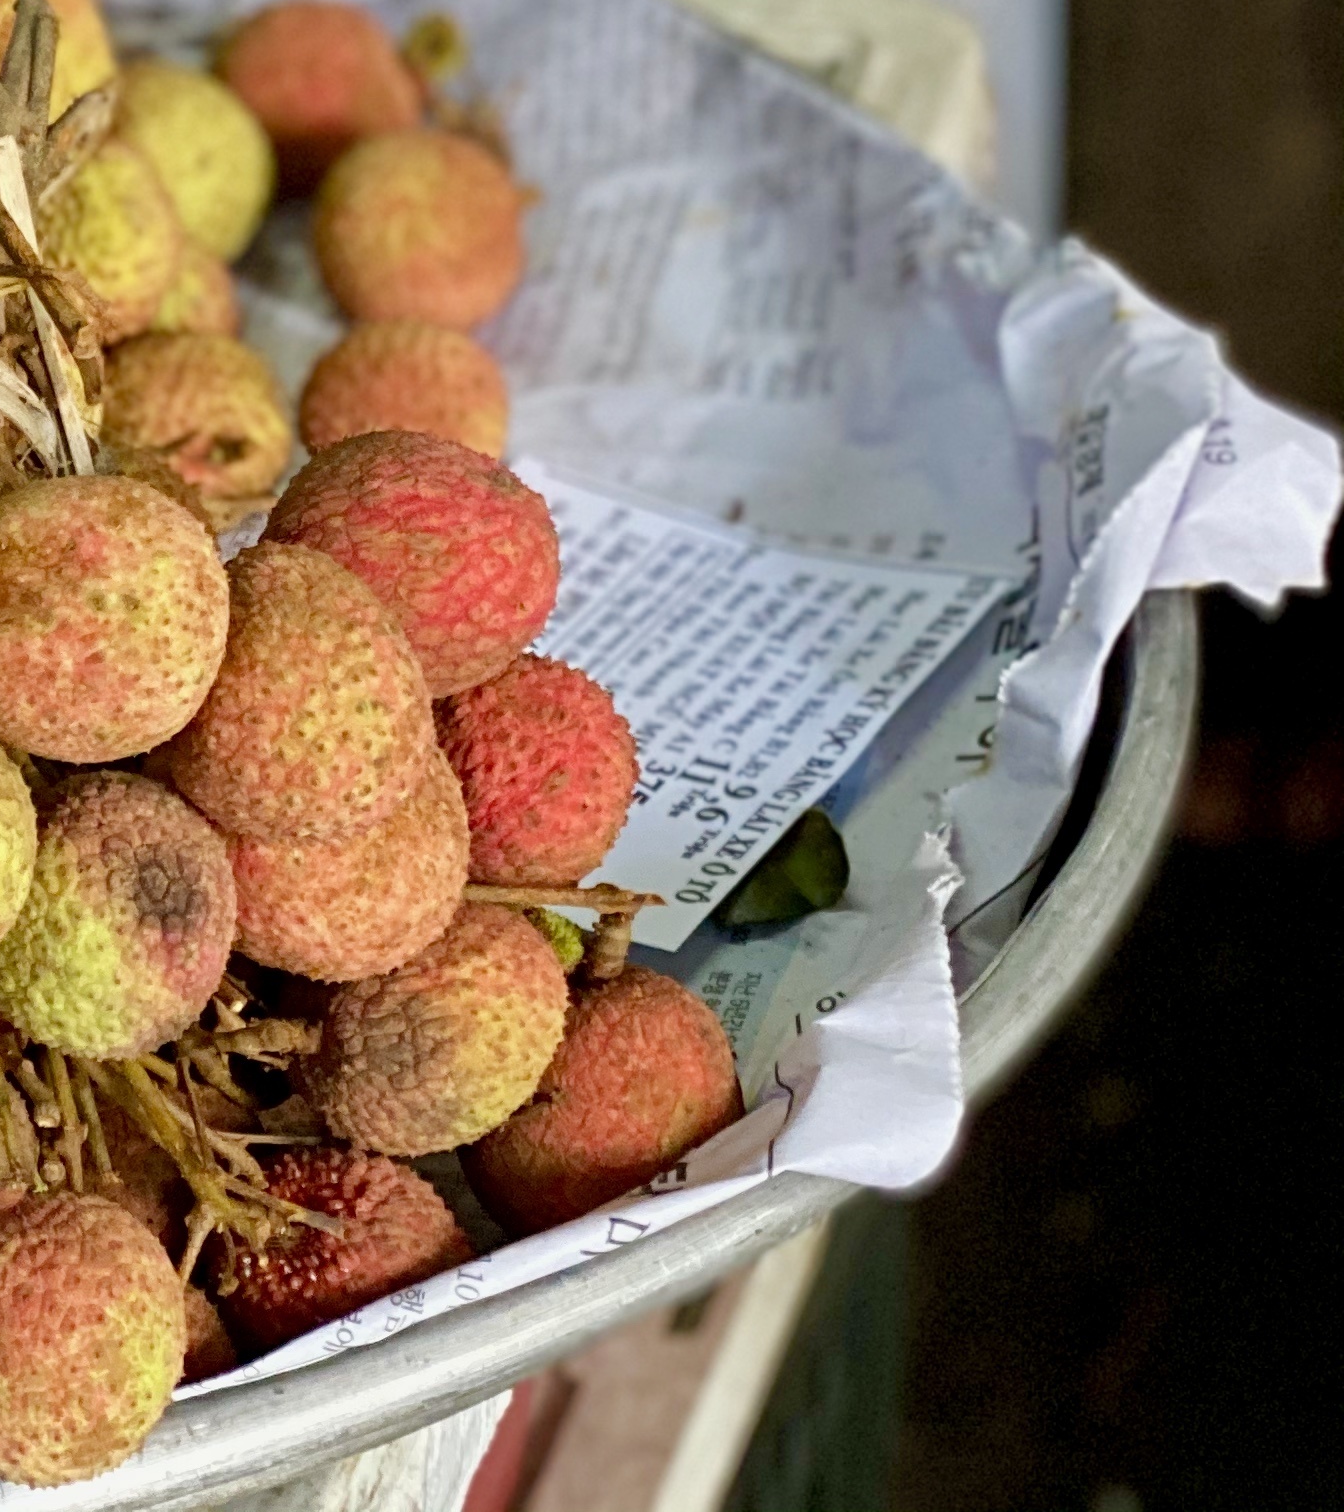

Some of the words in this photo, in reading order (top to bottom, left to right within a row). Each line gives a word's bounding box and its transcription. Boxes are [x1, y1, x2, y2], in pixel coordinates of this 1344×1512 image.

[818, 713, 871, 756] HỌC
[695, 781, 759, 826] 9,6
[740, 801, 790, 836] LÁI
[715, 833, 759, 861] XE
[701, 860, 737, 877] Ô
[674, 877, 717, 905] TÔ
